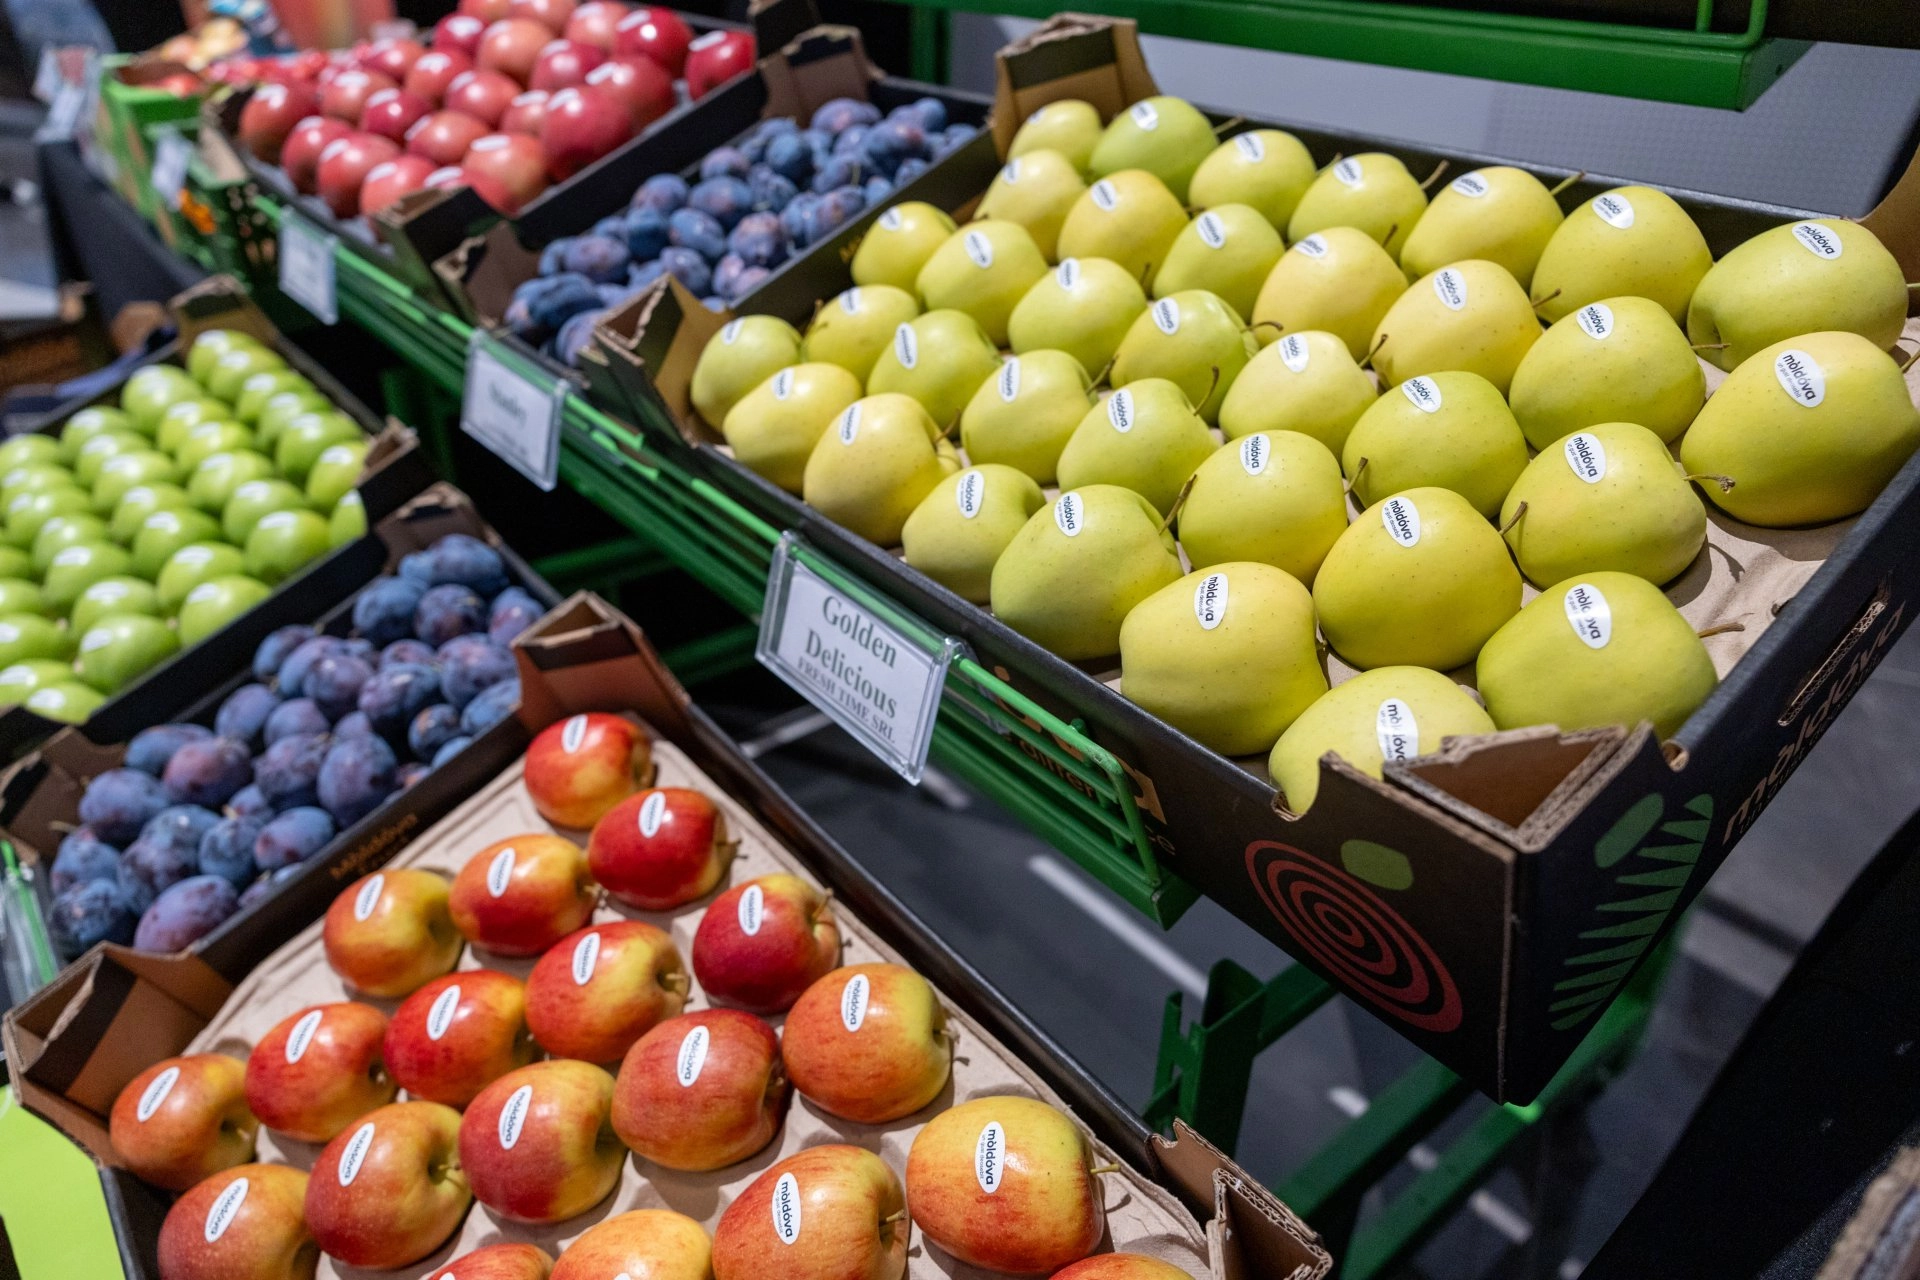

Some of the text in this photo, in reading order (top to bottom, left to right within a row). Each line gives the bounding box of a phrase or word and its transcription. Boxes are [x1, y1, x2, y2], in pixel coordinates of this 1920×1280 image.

[805, 629, 897, 719] Delicious
[823, 595, 897, 668] Golden
[798, 657, 896, 744] FRESH TIME SRL
